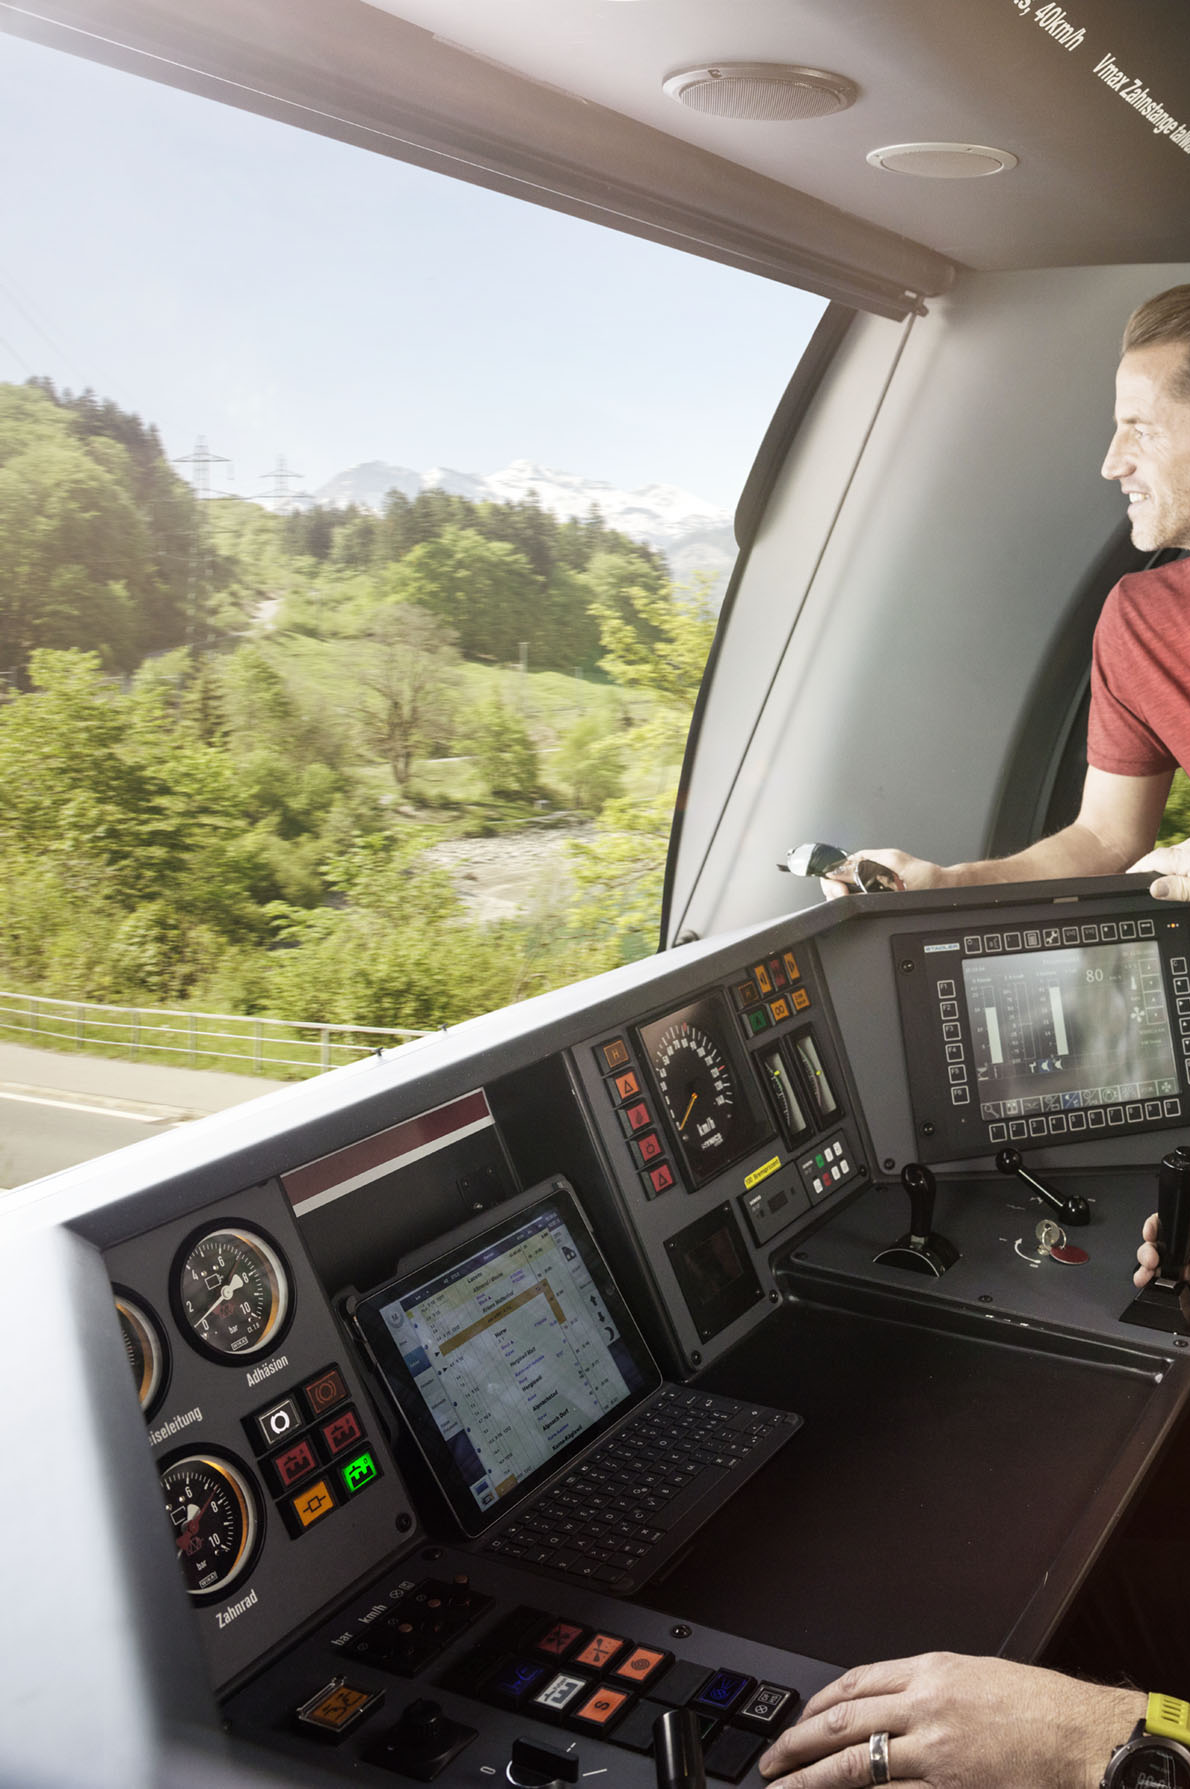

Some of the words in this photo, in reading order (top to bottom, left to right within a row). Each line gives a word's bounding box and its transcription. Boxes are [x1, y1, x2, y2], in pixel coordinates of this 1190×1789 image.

[1034, 2, 1087, 52] 40km/h
[1093, 53, 1130, 92] Vmax
[1119, 79, 1179, 134] Zahnstange
[1086, 969, 1104, 983] 80
[697, 1117, 716, 1136] km/h
[218, 1256, 225, 1267] 6
[192, 1270, 199, 1281] 4
[242, 1272, 249, 1284] 8
[186, 1301, 194, 1313] 2
[240, 1302, 251, 1315] 10
[202, 1320, 209, 1331] 0
[228, 1325, 238, 1334] bar
[246, 1355, 289, 1387] Adhäsion
[185, 1486, 193, 1499] 6
[211, 1501, 219, 1513] 8
[209, 1533, 221, 1547] 10
[196, 1559, 207, 1571] bar
[215, 1589, 259, 1629] Zahnrad
[358, 1604, 387, 1624] km/h
[331, 1632, 353, 1646] bar
[594, 1701, 610, 1711] S
